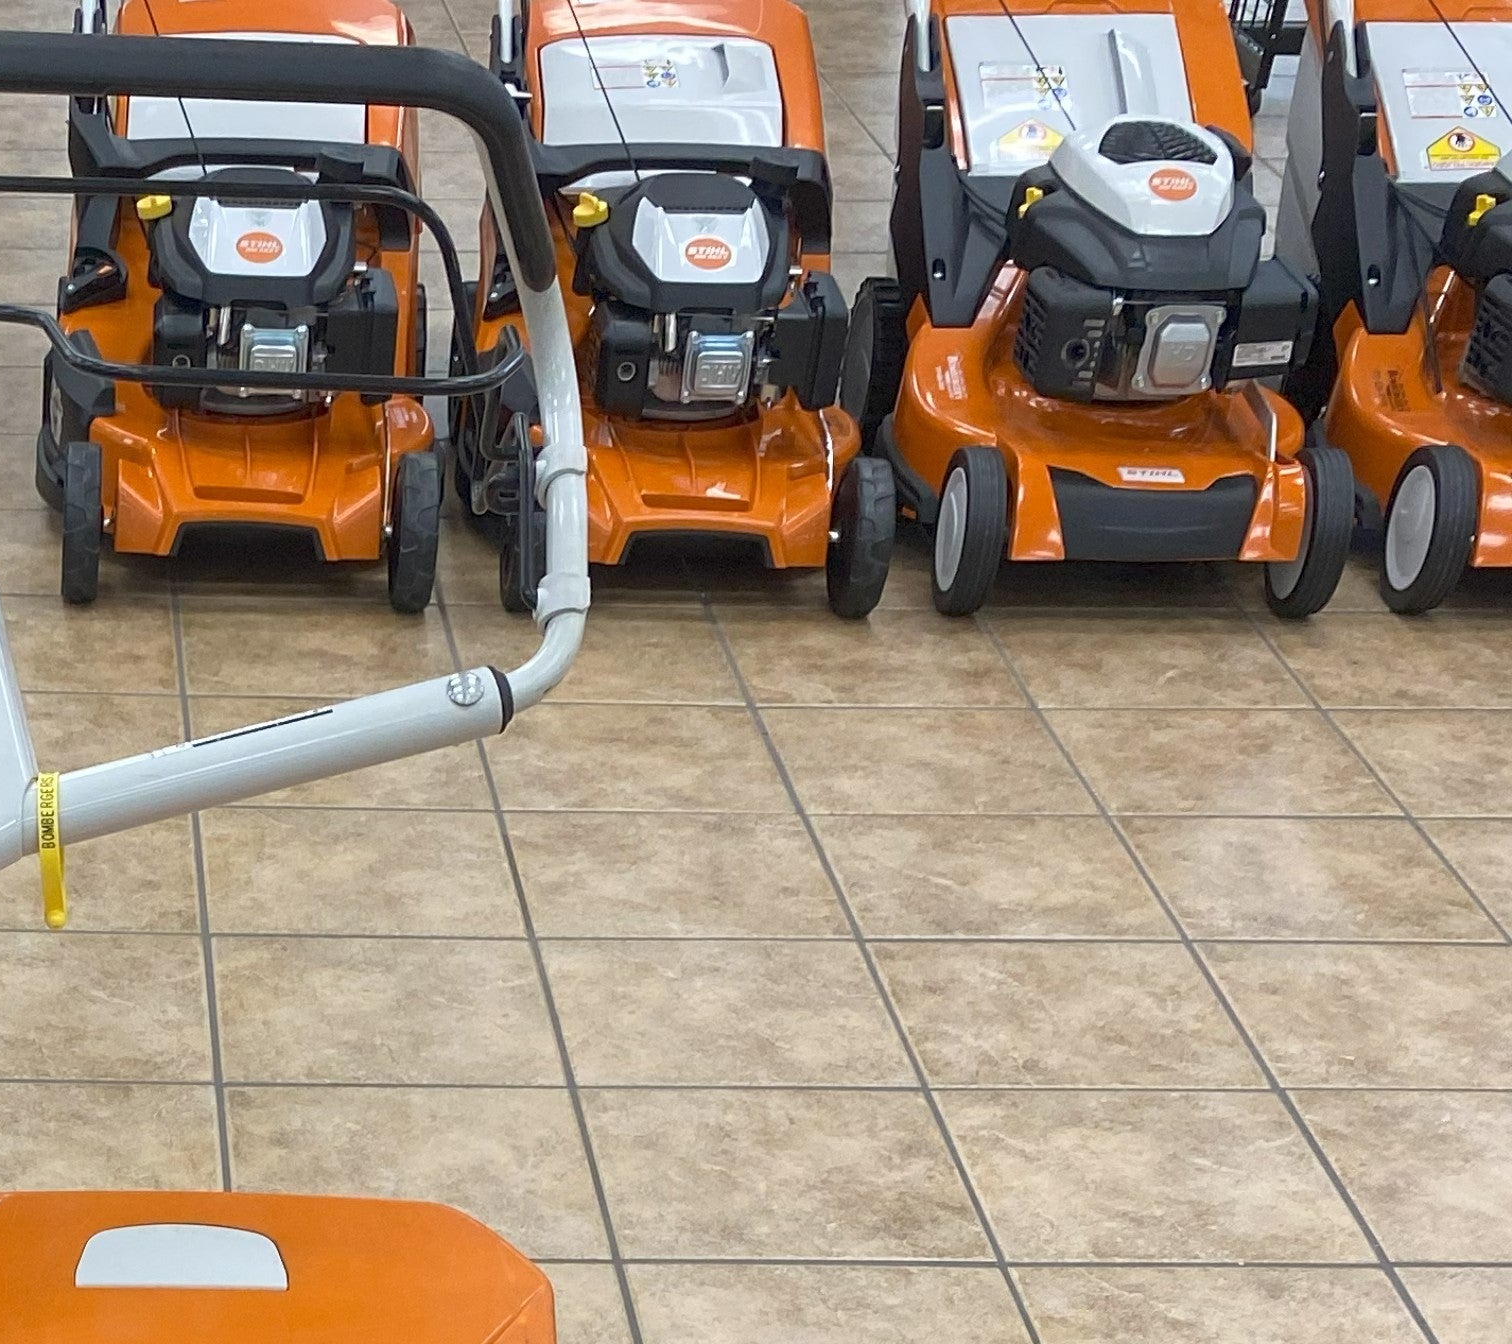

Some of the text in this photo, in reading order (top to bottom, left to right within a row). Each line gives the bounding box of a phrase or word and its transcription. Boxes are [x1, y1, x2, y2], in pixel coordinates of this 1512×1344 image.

[239, 239, 279, 249] STIHL
[687, 246, 729, 256] STIHL
[40, 775, 56, 849] BOMBERGERS
